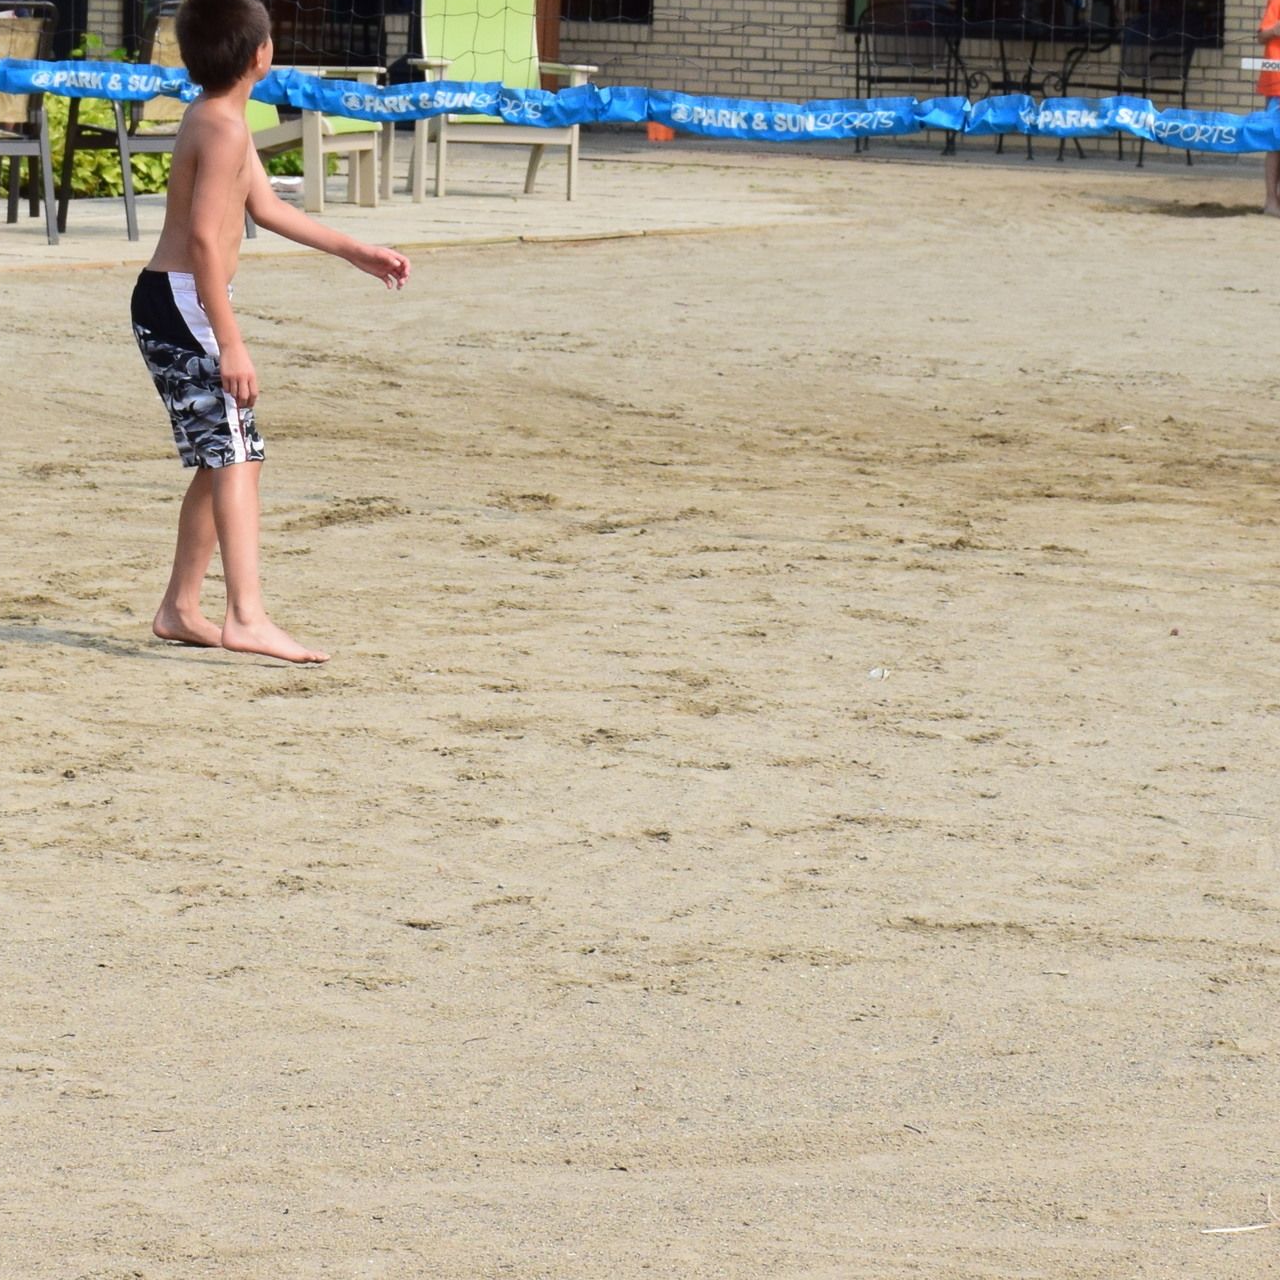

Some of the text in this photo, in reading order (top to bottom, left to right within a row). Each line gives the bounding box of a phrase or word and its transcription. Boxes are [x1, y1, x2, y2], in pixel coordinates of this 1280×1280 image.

[53, 71, 106, 90] PARK
[108, 73, 123, 91] &
[693, 107, 748, 130] PARK
[752, 111, 768, 131] &
[1038, 110, 1099, 130] PARK
